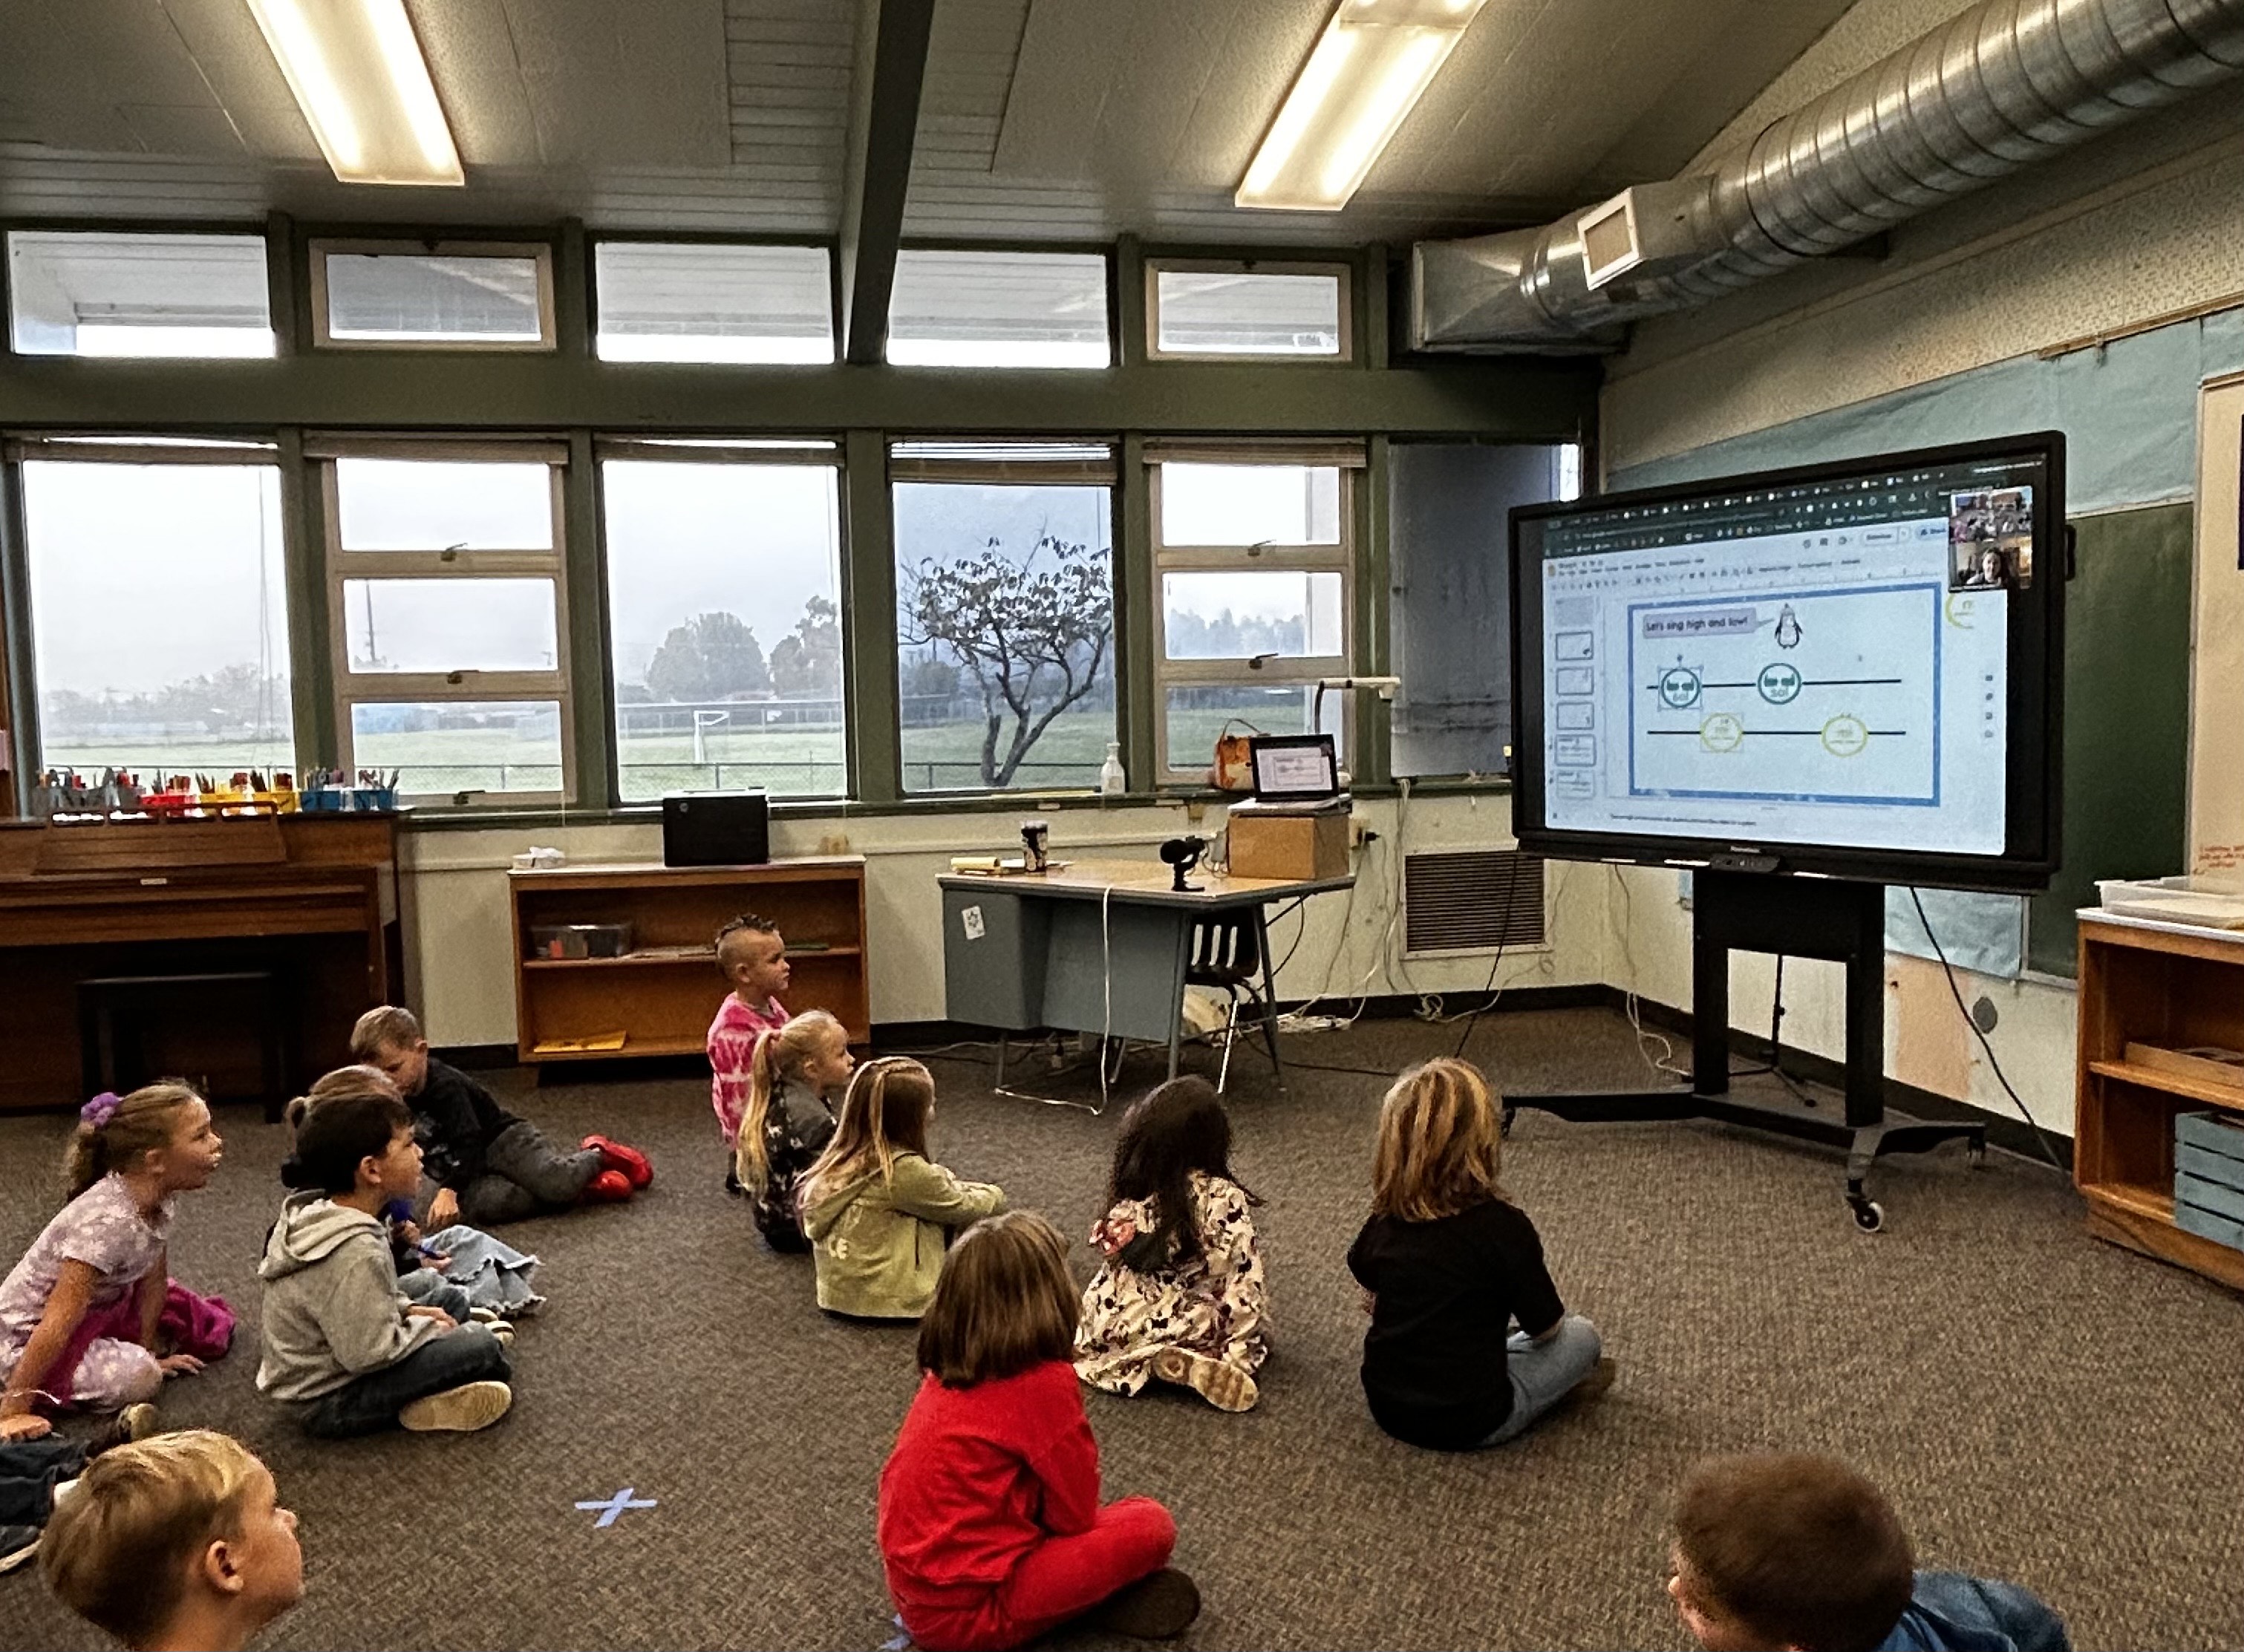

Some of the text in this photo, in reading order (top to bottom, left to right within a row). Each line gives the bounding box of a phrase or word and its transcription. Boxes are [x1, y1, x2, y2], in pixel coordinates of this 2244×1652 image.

[1666, 621, 1684, 632] sing
[1686, 618, 1706, 631] high
[1708, 618, 1726, 628] and
